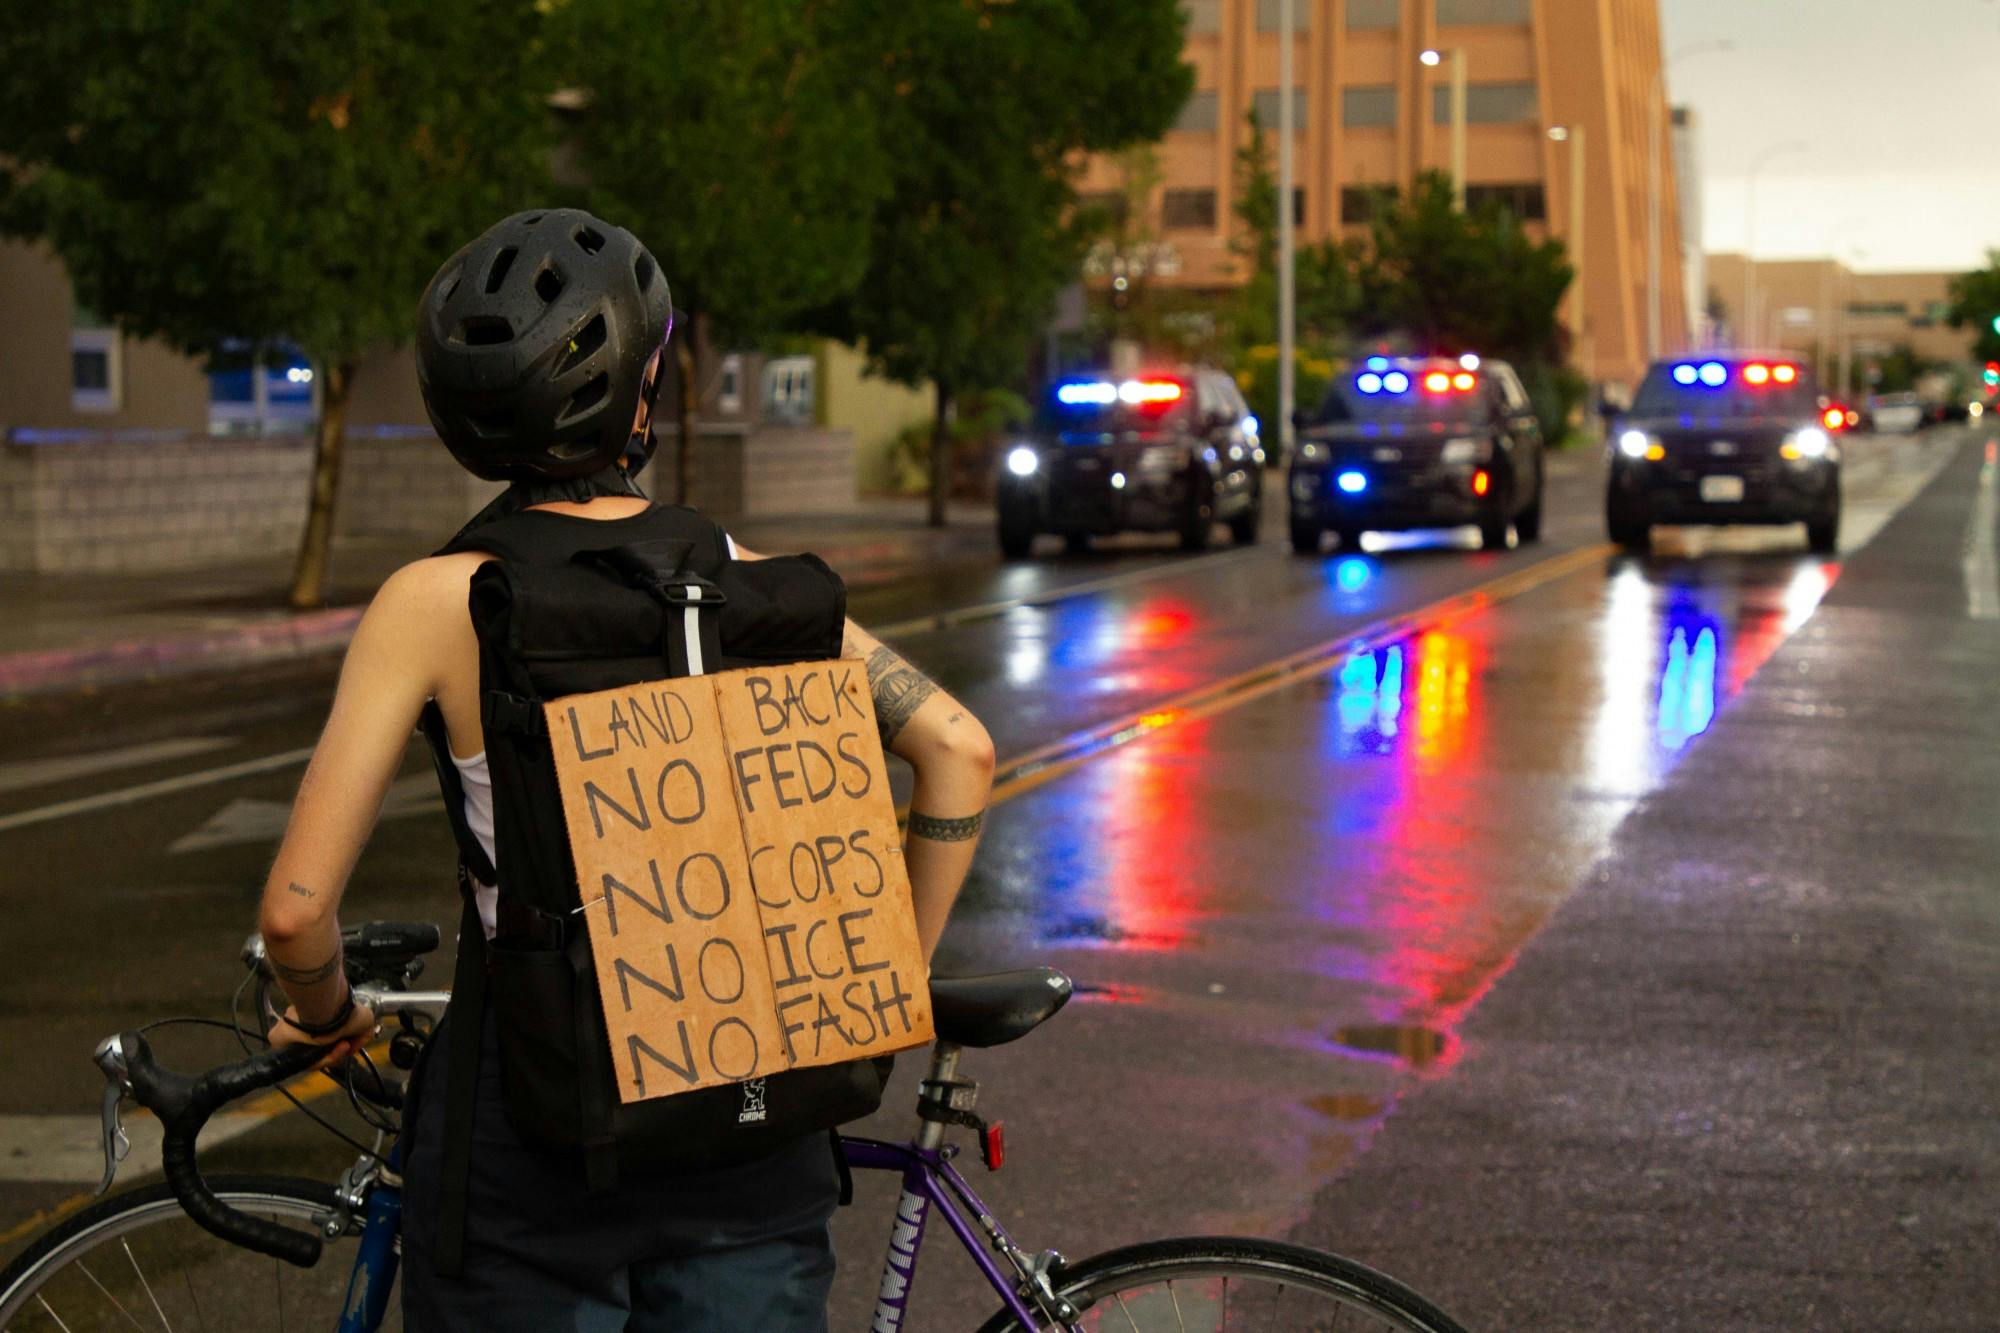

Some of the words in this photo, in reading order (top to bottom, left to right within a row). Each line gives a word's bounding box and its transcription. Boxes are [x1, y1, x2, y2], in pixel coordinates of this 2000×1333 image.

[568, 691, 693, 761] LAND
[745, 669, 865, 736] BACK
[584, 759, 705, 838] NO
[734, 732, 871, 812] FEDS
[602, 853, 730, 937] NO
[751, 830, 883, 908] COPS
[614, 938, 744, 1012] NO
[765, 908, 890, 989] ICE
[628, 1017, 758, 1098] NO
[777, 971, 912, 1063] FASH
[738, 1109, 767, 1123] CHROME
